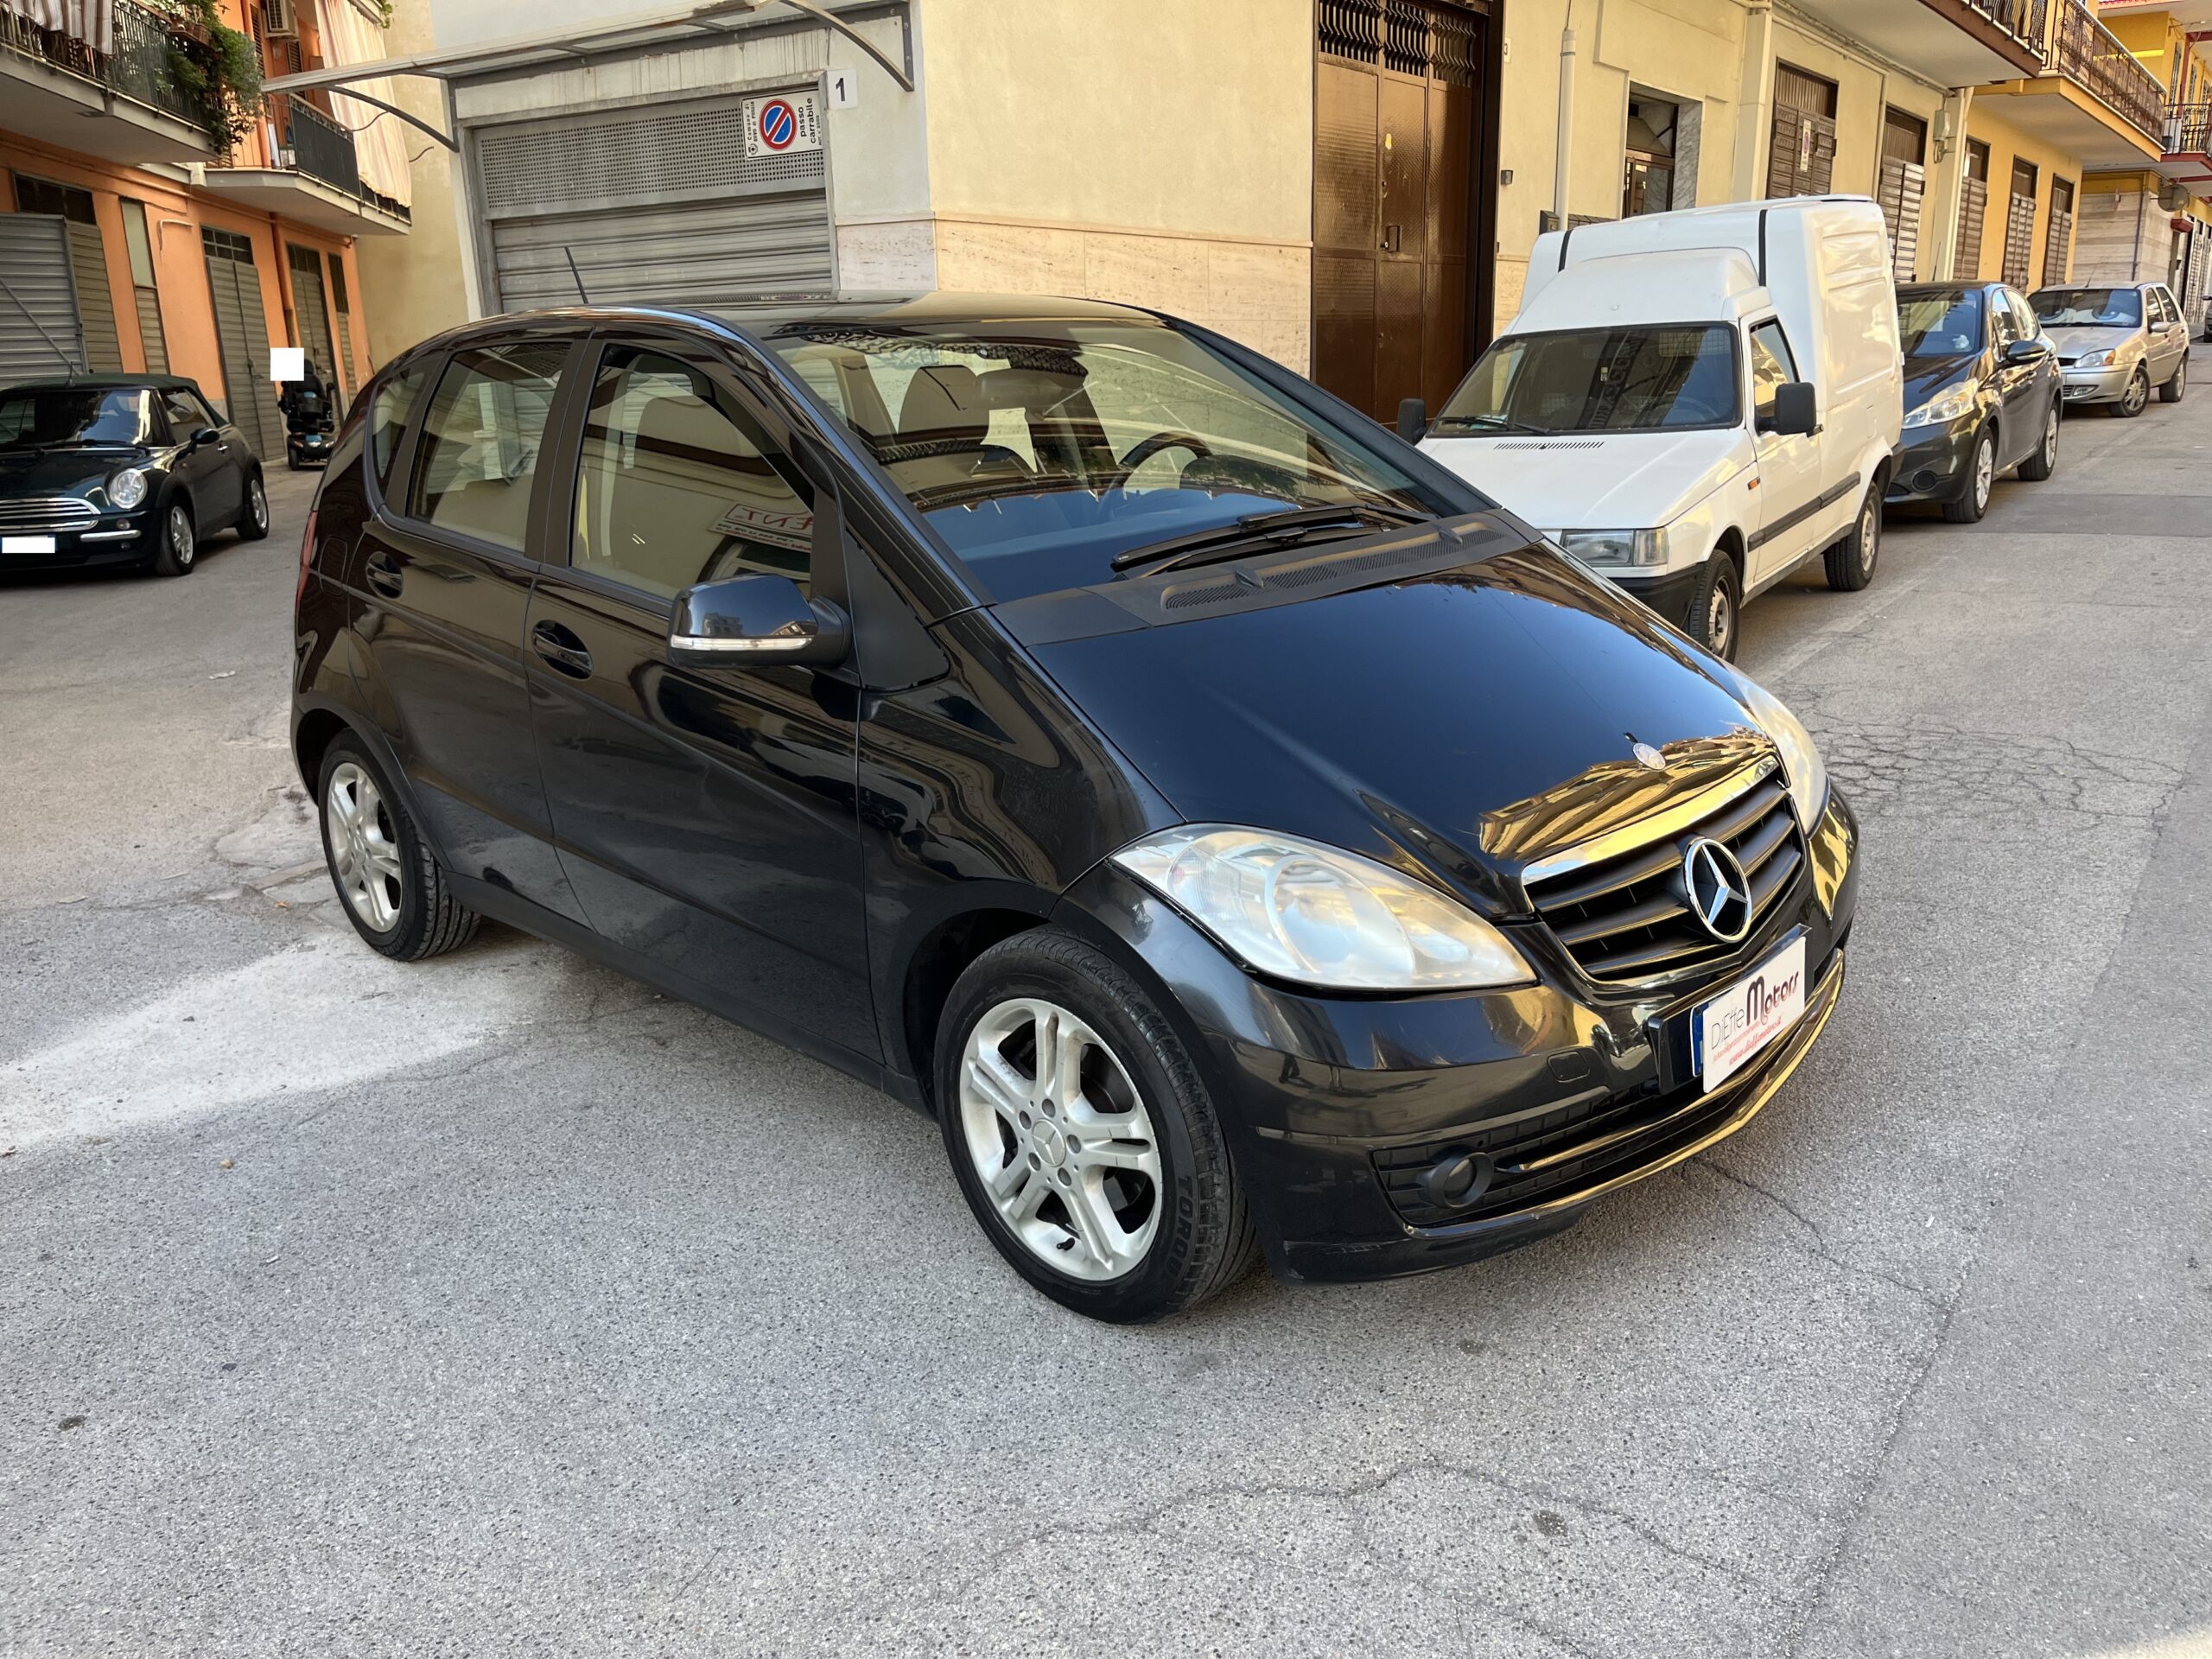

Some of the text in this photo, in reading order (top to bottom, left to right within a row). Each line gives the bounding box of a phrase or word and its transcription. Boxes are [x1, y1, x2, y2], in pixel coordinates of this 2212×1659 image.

[836, 77, 845, 102] 1
[798, 106, 807, 137] passo
[805, 98, 817, 144] carrabile
